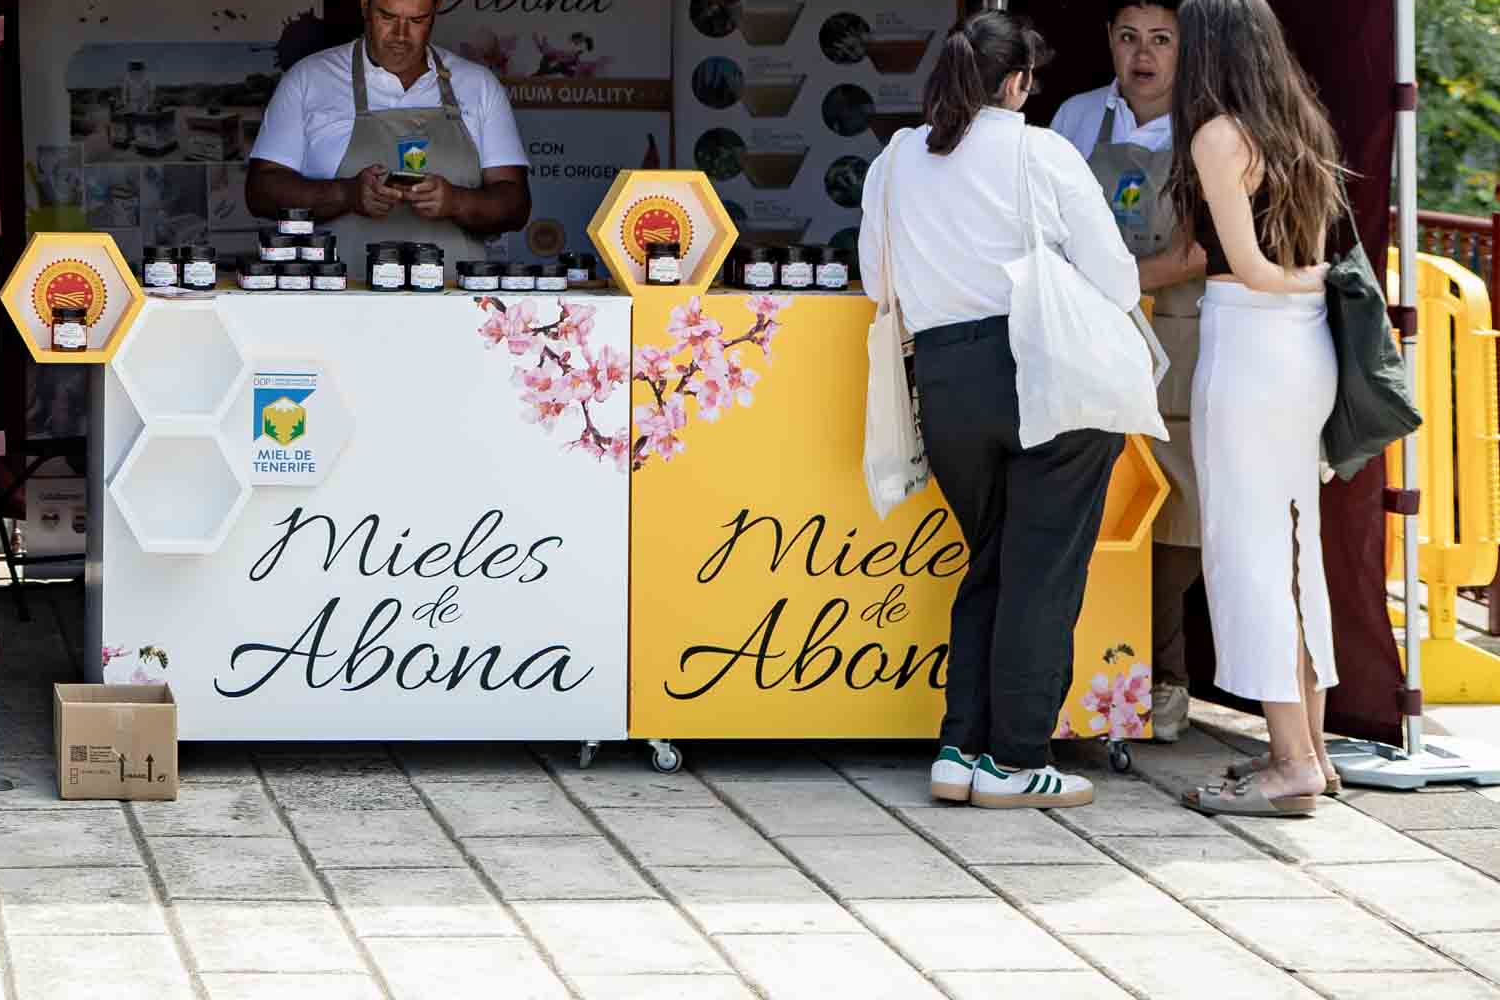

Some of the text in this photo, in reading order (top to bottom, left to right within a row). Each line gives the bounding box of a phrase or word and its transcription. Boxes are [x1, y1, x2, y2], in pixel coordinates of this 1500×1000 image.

[560, 87, 636, 103] QUALITY
[529, 142, 564, 154] CON
[253, 462, 317, 473] TENERIFE
[257, 449, 312, 461] MIEL DE
[249, 507, 563, 583] Mieles
[697, 508, 970, 584] Miele
[412, 584, 463, 628] de
[860, 583, 910, 628] de
[214, 596, 595, 698] Abona
[664, 598, 950, 700] Abon
